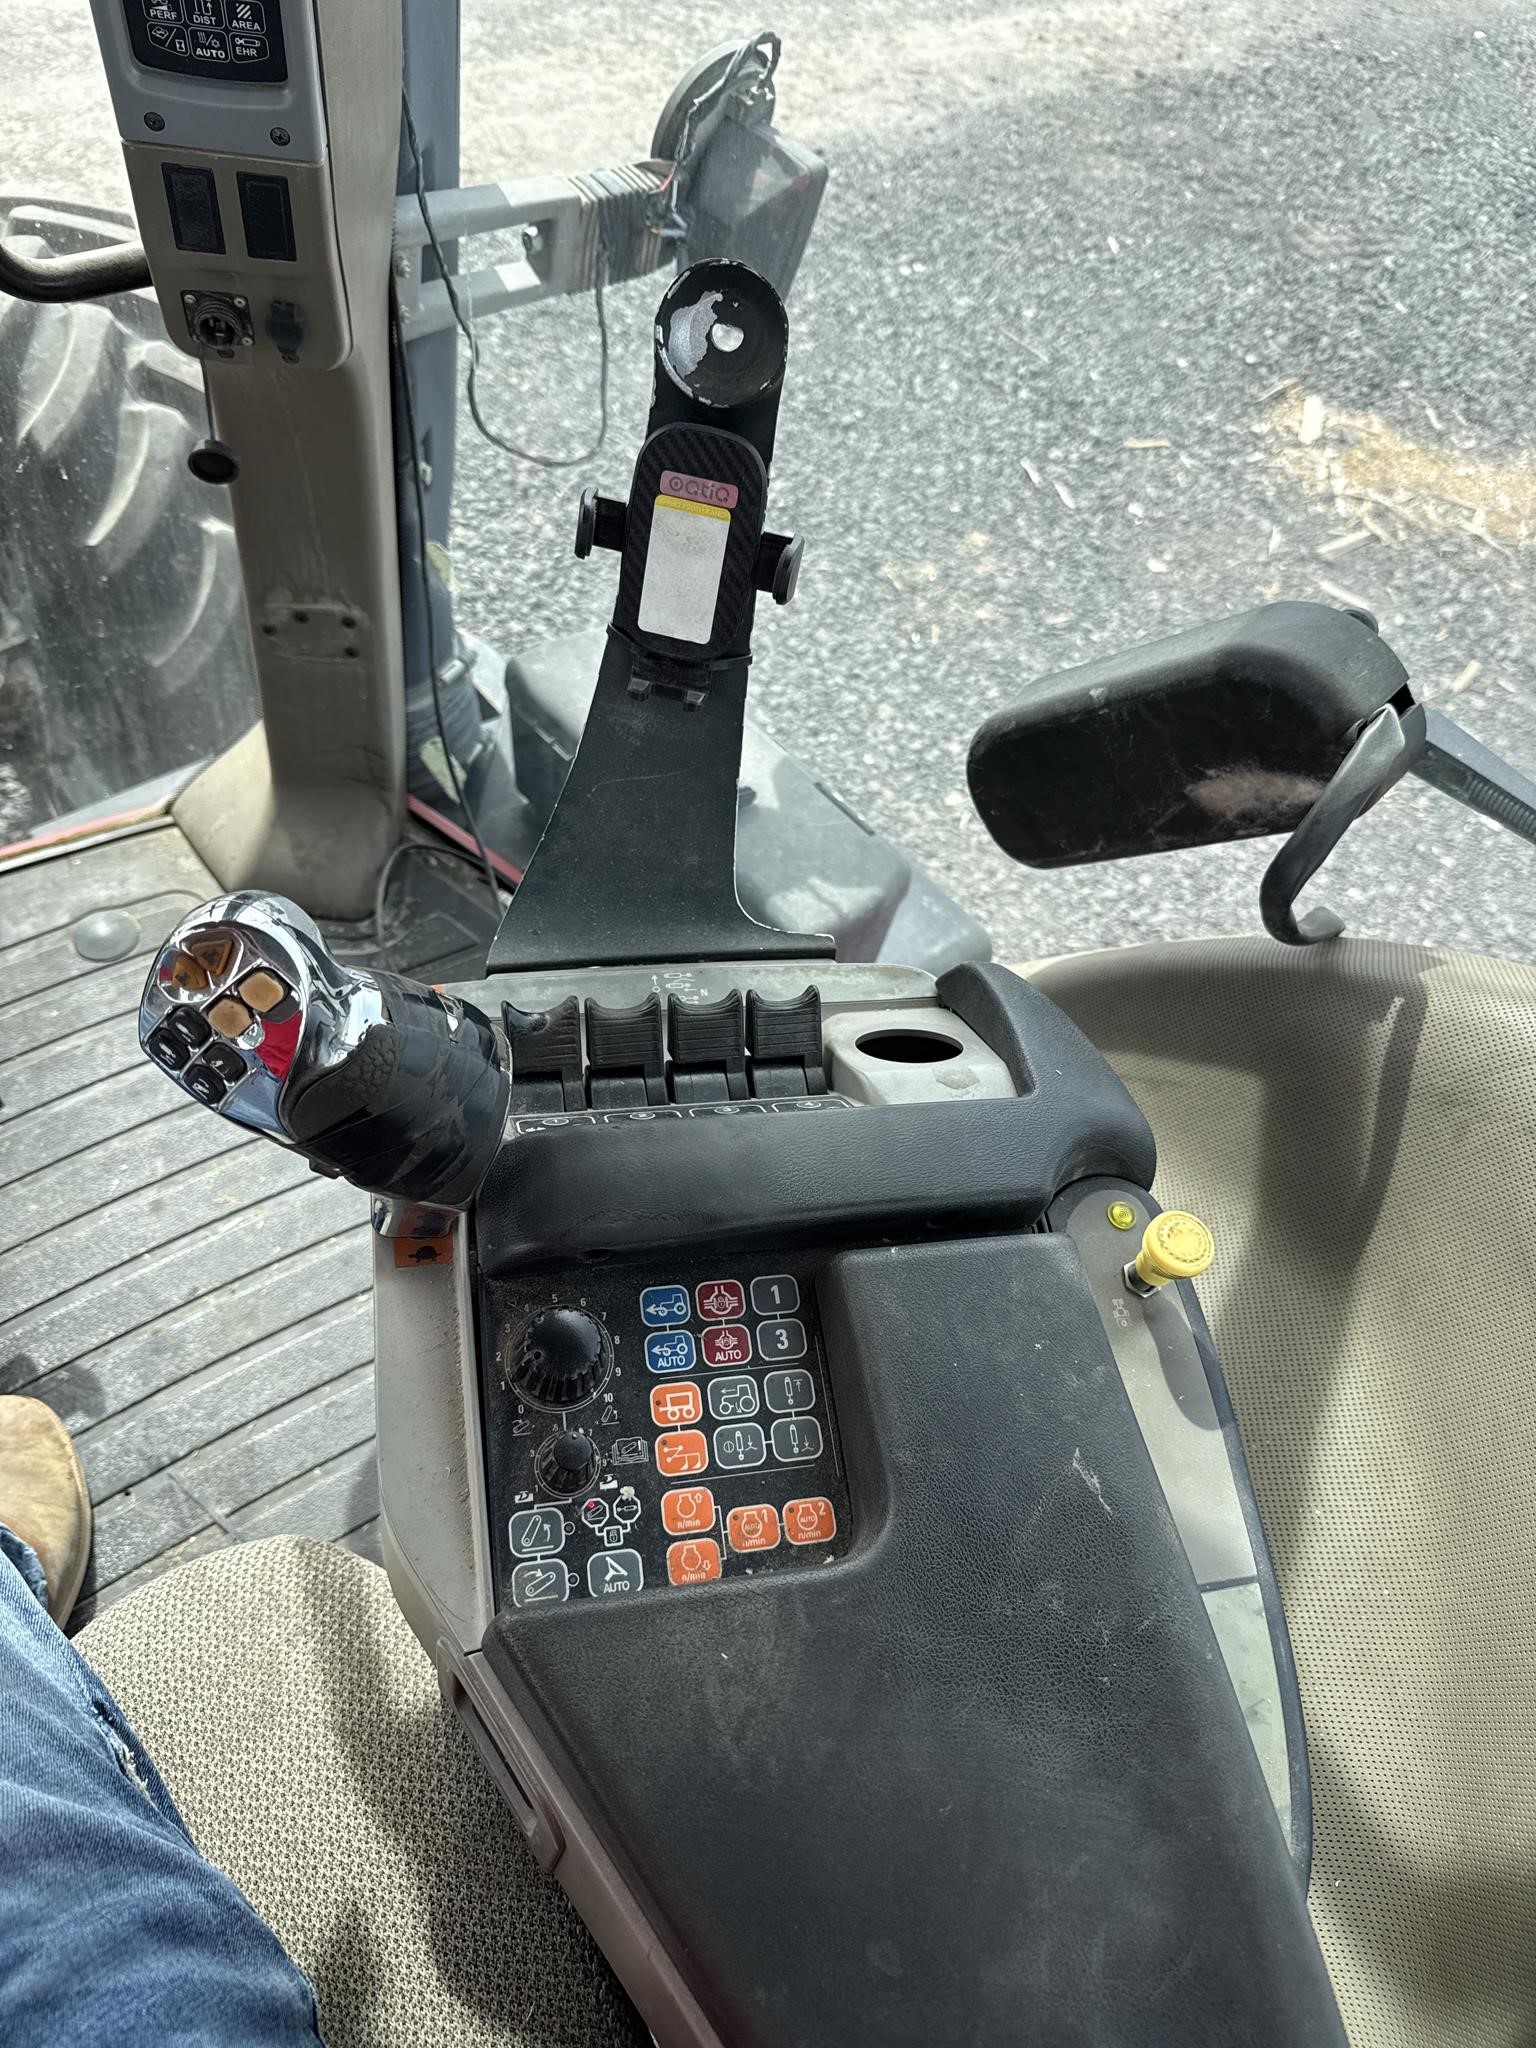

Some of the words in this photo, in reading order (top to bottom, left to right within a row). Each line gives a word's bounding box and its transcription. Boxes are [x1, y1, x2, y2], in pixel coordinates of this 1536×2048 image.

[149, 9, 178, 20] PERF
[193, 15, 217, 26] DIST
[231, 19, 261, 31] AREA
[196, 47, 226, 59] AUTO
[236, 46, 258, 57] EHR
[551, 1293, 559, 1303] 5
[770, 1284, 781, 1304] 1
[580, 1297, 587, 1307] 6
[504, 1323, 511, 1333] 3
[614, 1335, 621, 1345] 8
[775, 1328, 789, 1350] 3
[496, 1351, 502, 1361] 2
[714, 1349, 742, 1362] AUTO
[657, 1355, 686, 1368] AUTO
[615, 1366, 622, 1377] 9
[500, 1380, 506, 1391] 1
[602, 1392, 614, 1403] 10
[517, 1404, 525, 1414] 0
[529, 1449, 535, 1458] 3
[818, 1501, 827, 1516] 2
[761, 1508, 768, 1523] 1
[800, 1515, 816, 1523] AUTO
[677, 1518, 701, 1529] n/min
[798, 1529, 822, 1540] n/min
[603, 1580, 630, 1594] AUTO
